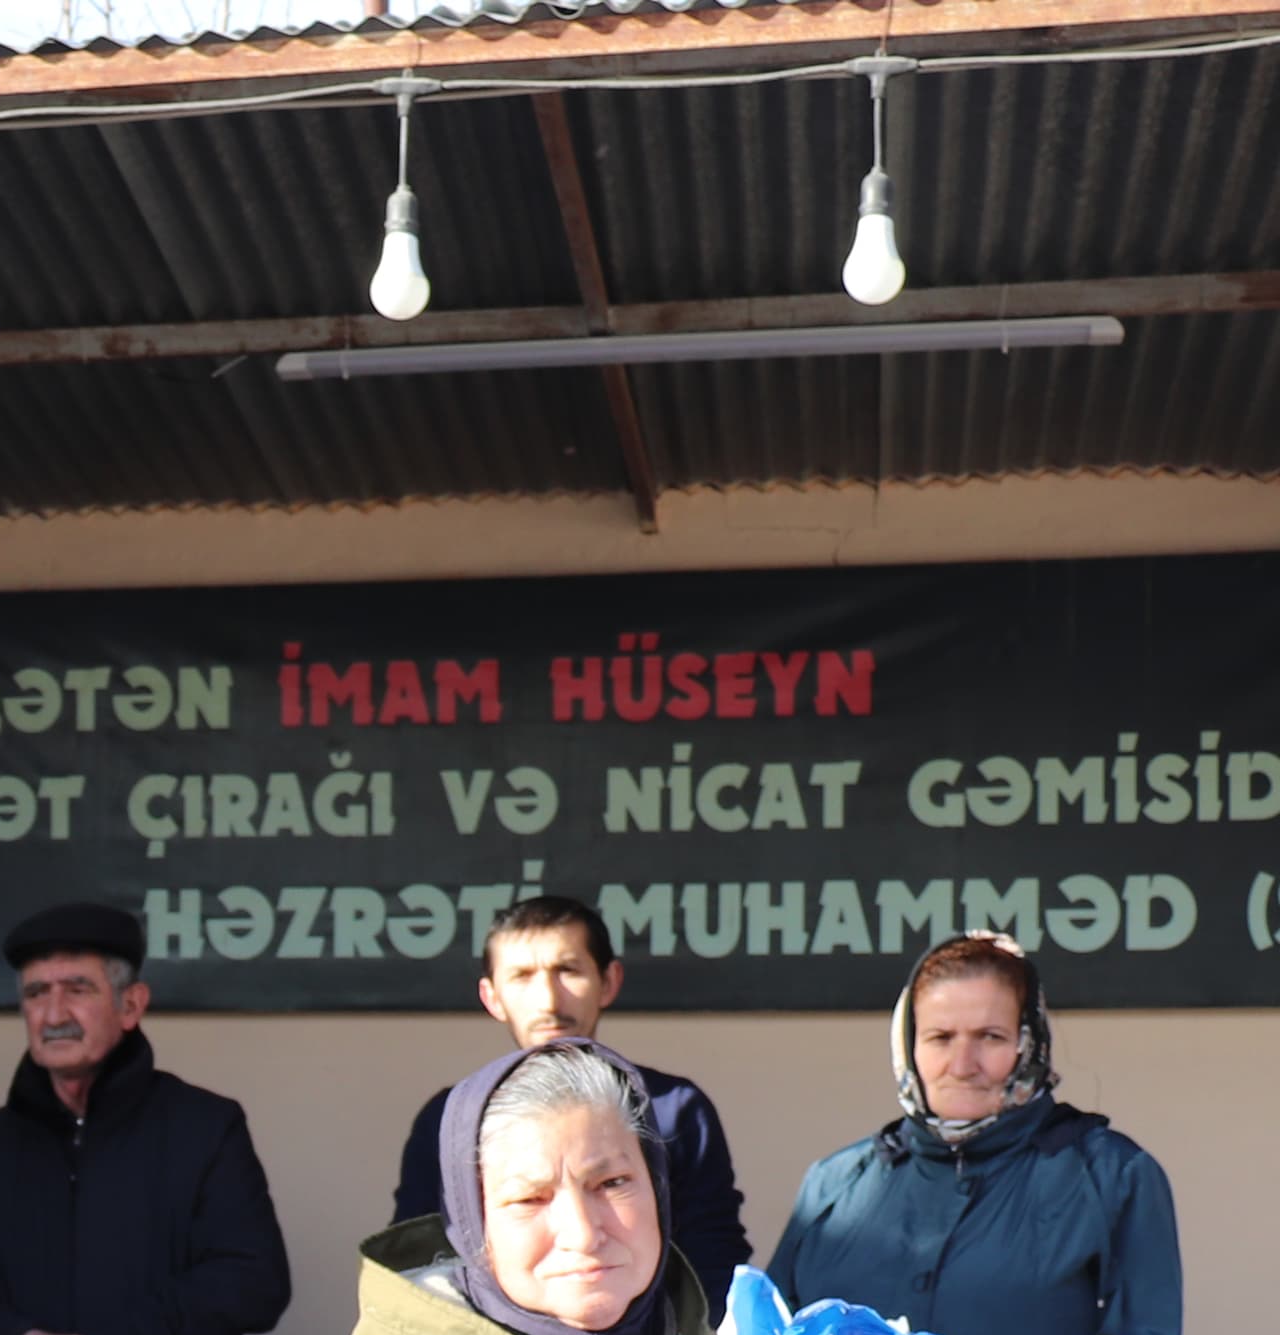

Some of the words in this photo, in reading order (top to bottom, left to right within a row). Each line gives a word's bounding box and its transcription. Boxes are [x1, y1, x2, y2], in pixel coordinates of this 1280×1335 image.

[279, 642, 503, 729] İMAM
[549, 633, 875, 722] HÜSEYN
[128, 752, 395, 858] ÇIRAĞI
[441, 768, 559, 834] VƏ
[603, 743, 861, 833] NİCAT
[907, 731, 1280, 828] GƏMİSİD
[597, 874, 1198, 958] MUHAMMƏD
